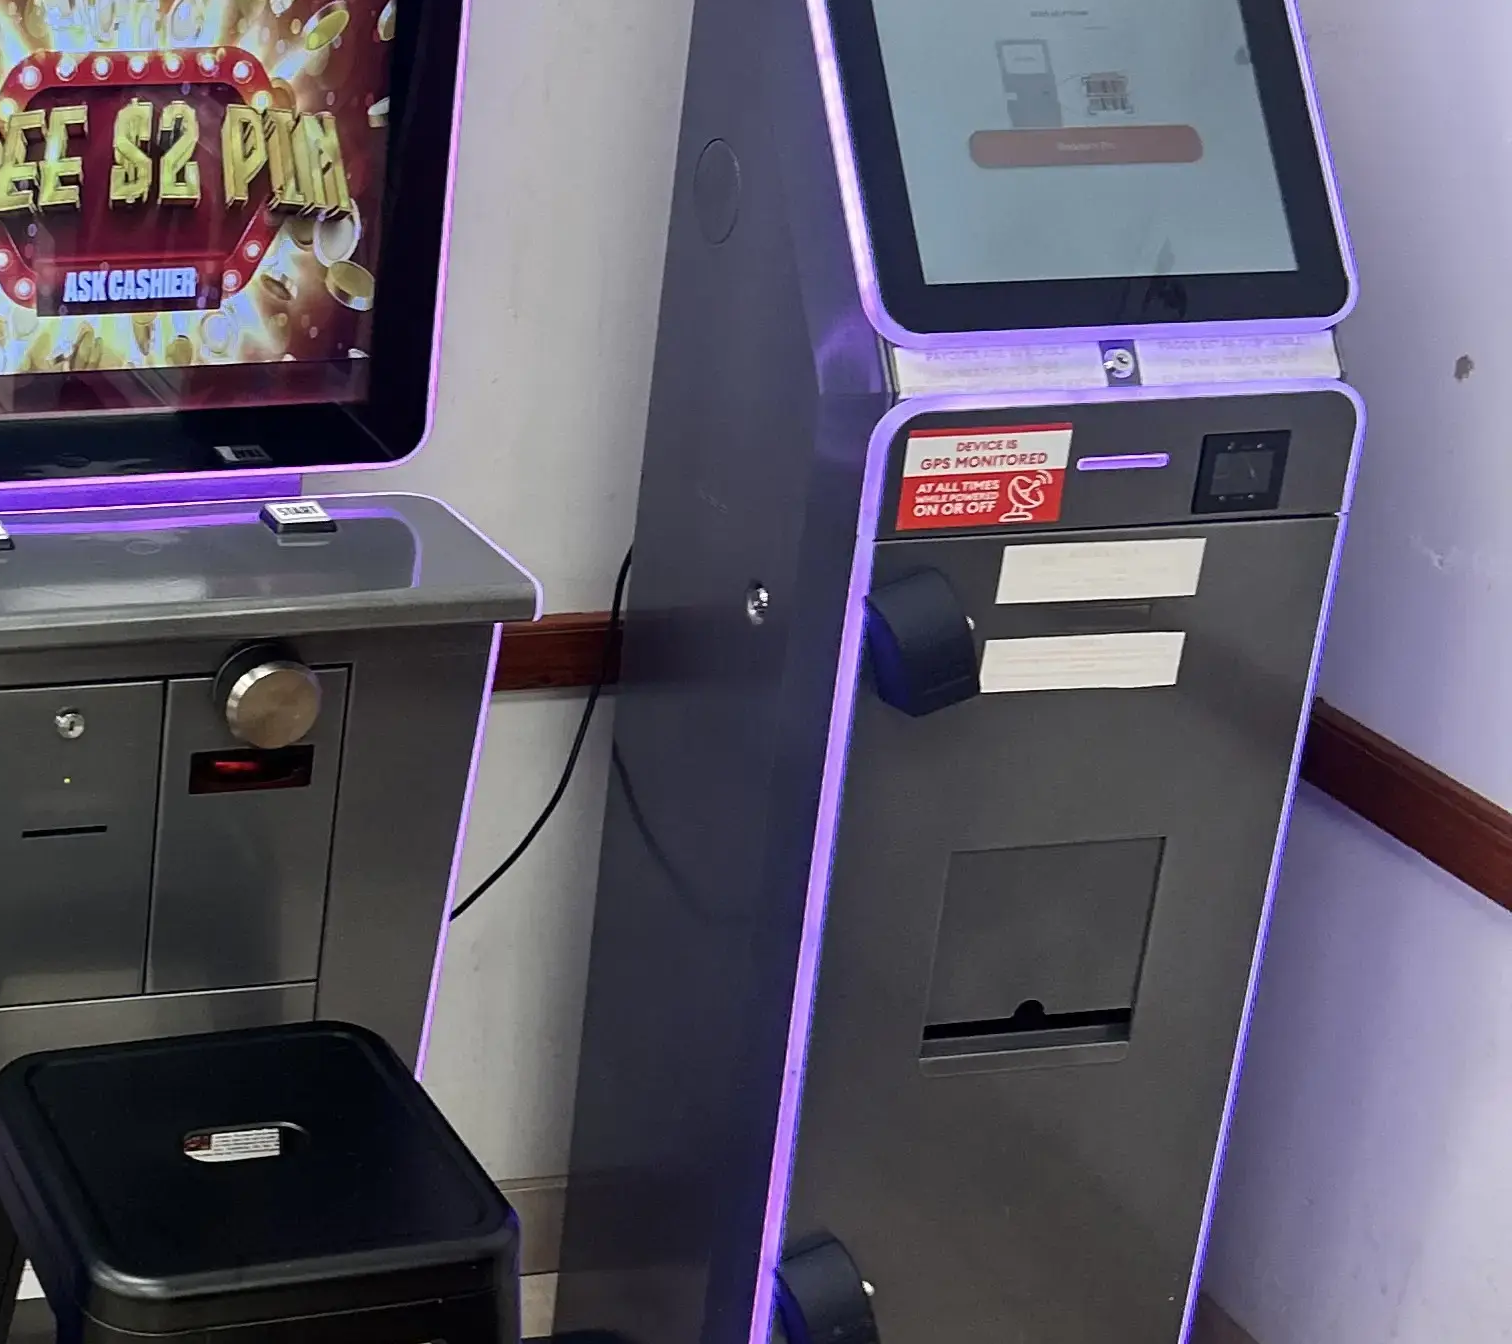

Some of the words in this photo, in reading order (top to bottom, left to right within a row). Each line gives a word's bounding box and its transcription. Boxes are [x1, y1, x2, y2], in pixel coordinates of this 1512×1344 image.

[109, 98, 201, 209] $2
[221, 104, 354, 218] PIN
[63, 271, 107, 302] ASK
[108, 267, 197, 301] CASHIER
[956, 440, 1003, 452] DEVICE
[1006, 439, 1018, 449] IS
[920, 457, 952, 470] GPS
[954, 452, 1048, 469] MONITORED
[916, 483, 935, 494] AT
[935, 481, 960, 492] ALL
[961, 479, 1000, 491] TIMES
[915, 494, 949, 503] WHILE
[949, 492, 999, 502] POWERED
[276, 506, 319, 516] START
[913, 505, 938, 517] ON
[941, 503, 964, 515] OR
[966, 501, 996, 514] OFF
